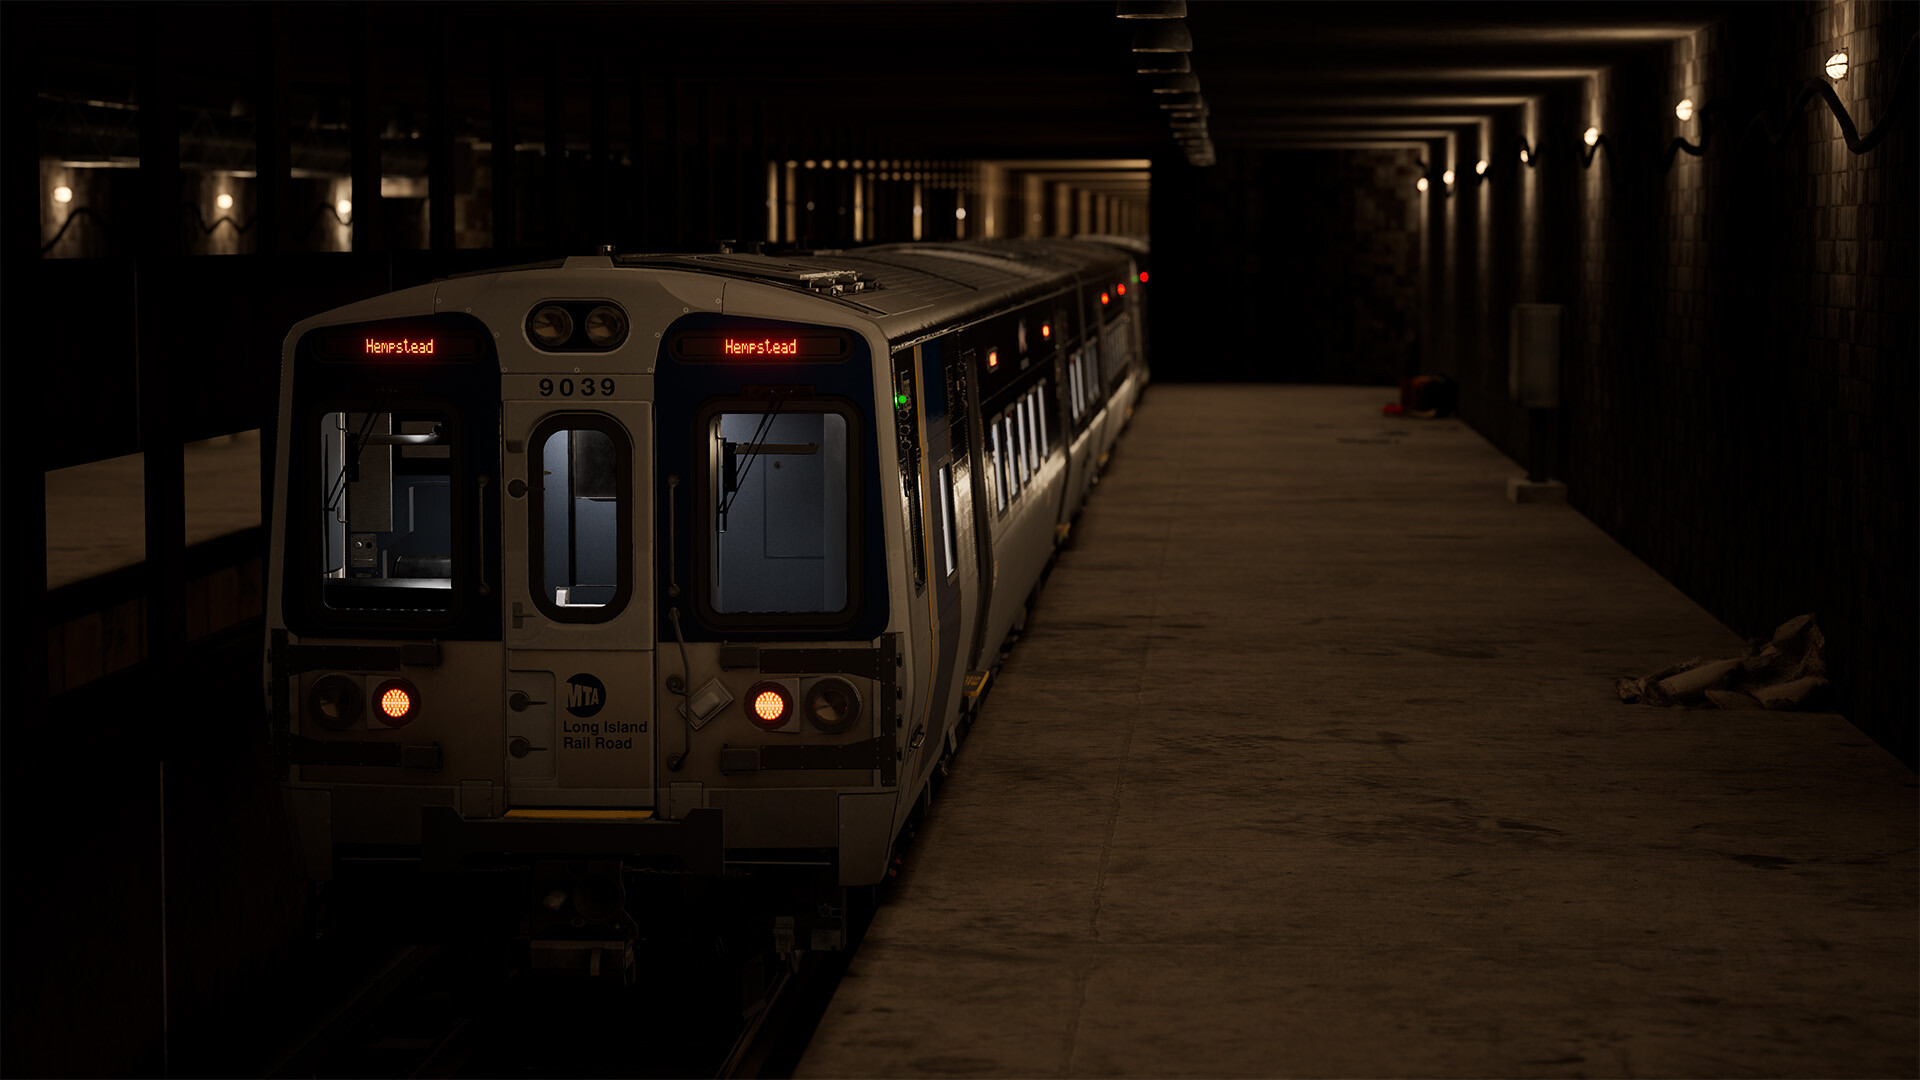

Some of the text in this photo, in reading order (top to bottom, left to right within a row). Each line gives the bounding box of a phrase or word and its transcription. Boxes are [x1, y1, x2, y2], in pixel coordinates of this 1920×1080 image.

[366, 338, 434, 354] Hempstead
[725, 338, 797, 354] Hempstead
[538, 377, 616, 397] 9039
[566, 682, 600, 709] MTA
[563, 720, 648, 736] Long Island
[563, 736, 633, 750] Rail Road
